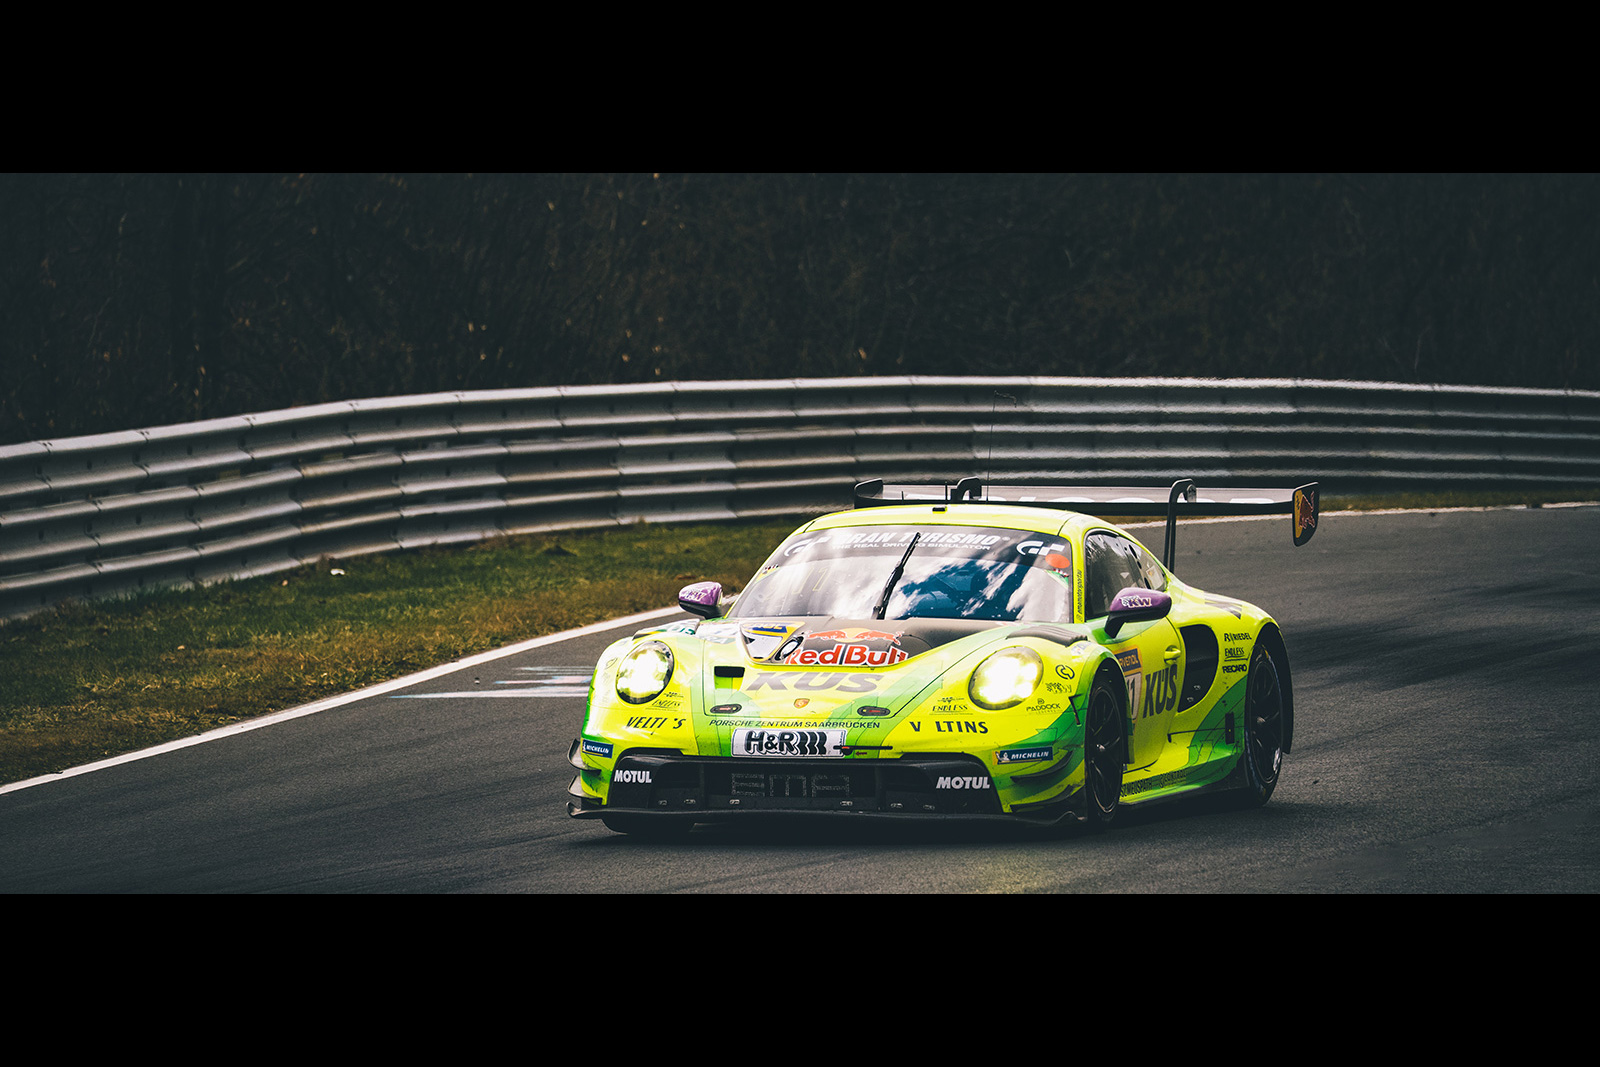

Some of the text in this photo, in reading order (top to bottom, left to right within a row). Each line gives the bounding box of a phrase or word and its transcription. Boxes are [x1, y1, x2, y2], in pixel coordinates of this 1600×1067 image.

[898, 532, 1001, 546] TURISMO
[927, 543, 991, 551] SIMULATOR
[1128, 597, 1153, 608] KW
[785, 643, 908, 666] Red Bull
[1222, 663, 1247, 674] RECARO
[932, 704, 968, 712] ENDLESS
[1026, 703, 1061, 712] PADDOCK
[709, 719, 881, 729] PORSCHE ZENTRUM SAARBRÜCKEN
[745, 730, 799, 755] H&R
[586, 744, 610, 754] MICHELIN
[1011, 751, 1049, 760] MICHELIN
[614, 769, 652, 783] MOTUL
[936, 776, 990, 790] MOTUL
